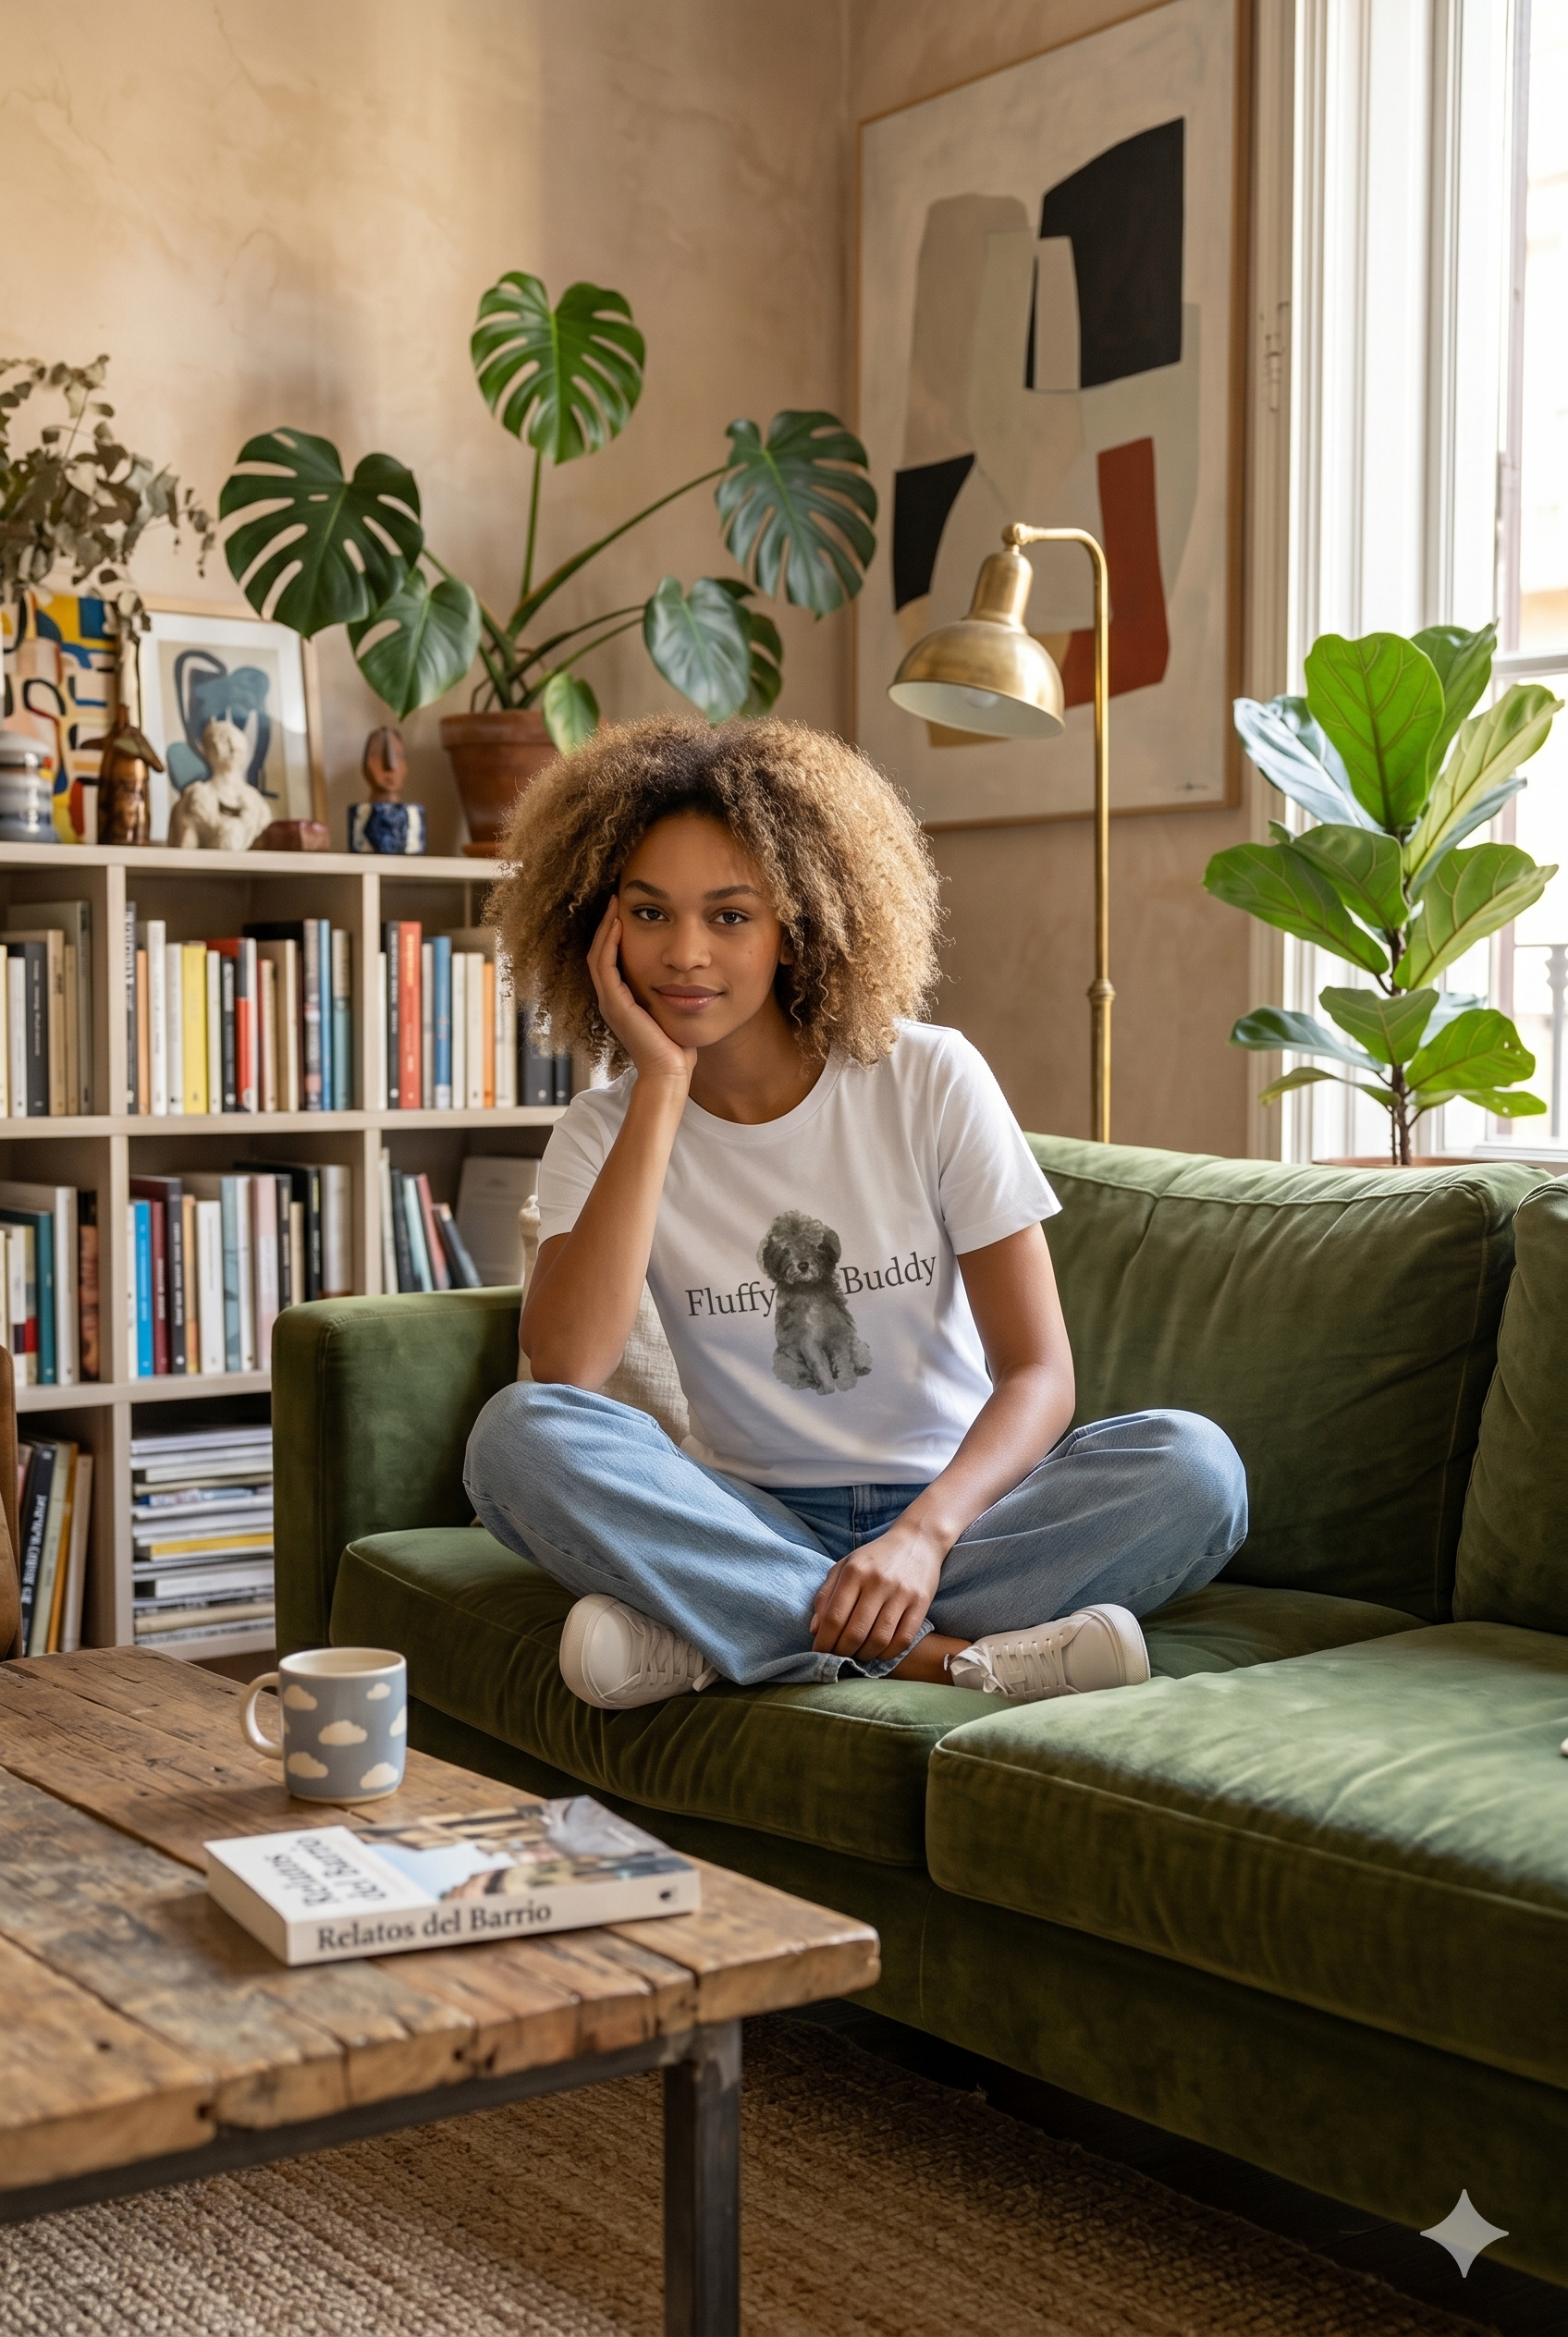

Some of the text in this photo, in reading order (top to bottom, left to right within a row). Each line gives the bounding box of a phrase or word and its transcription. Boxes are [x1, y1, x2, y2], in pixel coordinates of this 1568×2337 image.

[685, 1251, 937, 1317] Fluffy Buddy
[317, 1900, 552, 1952] Relatos del Barrio
